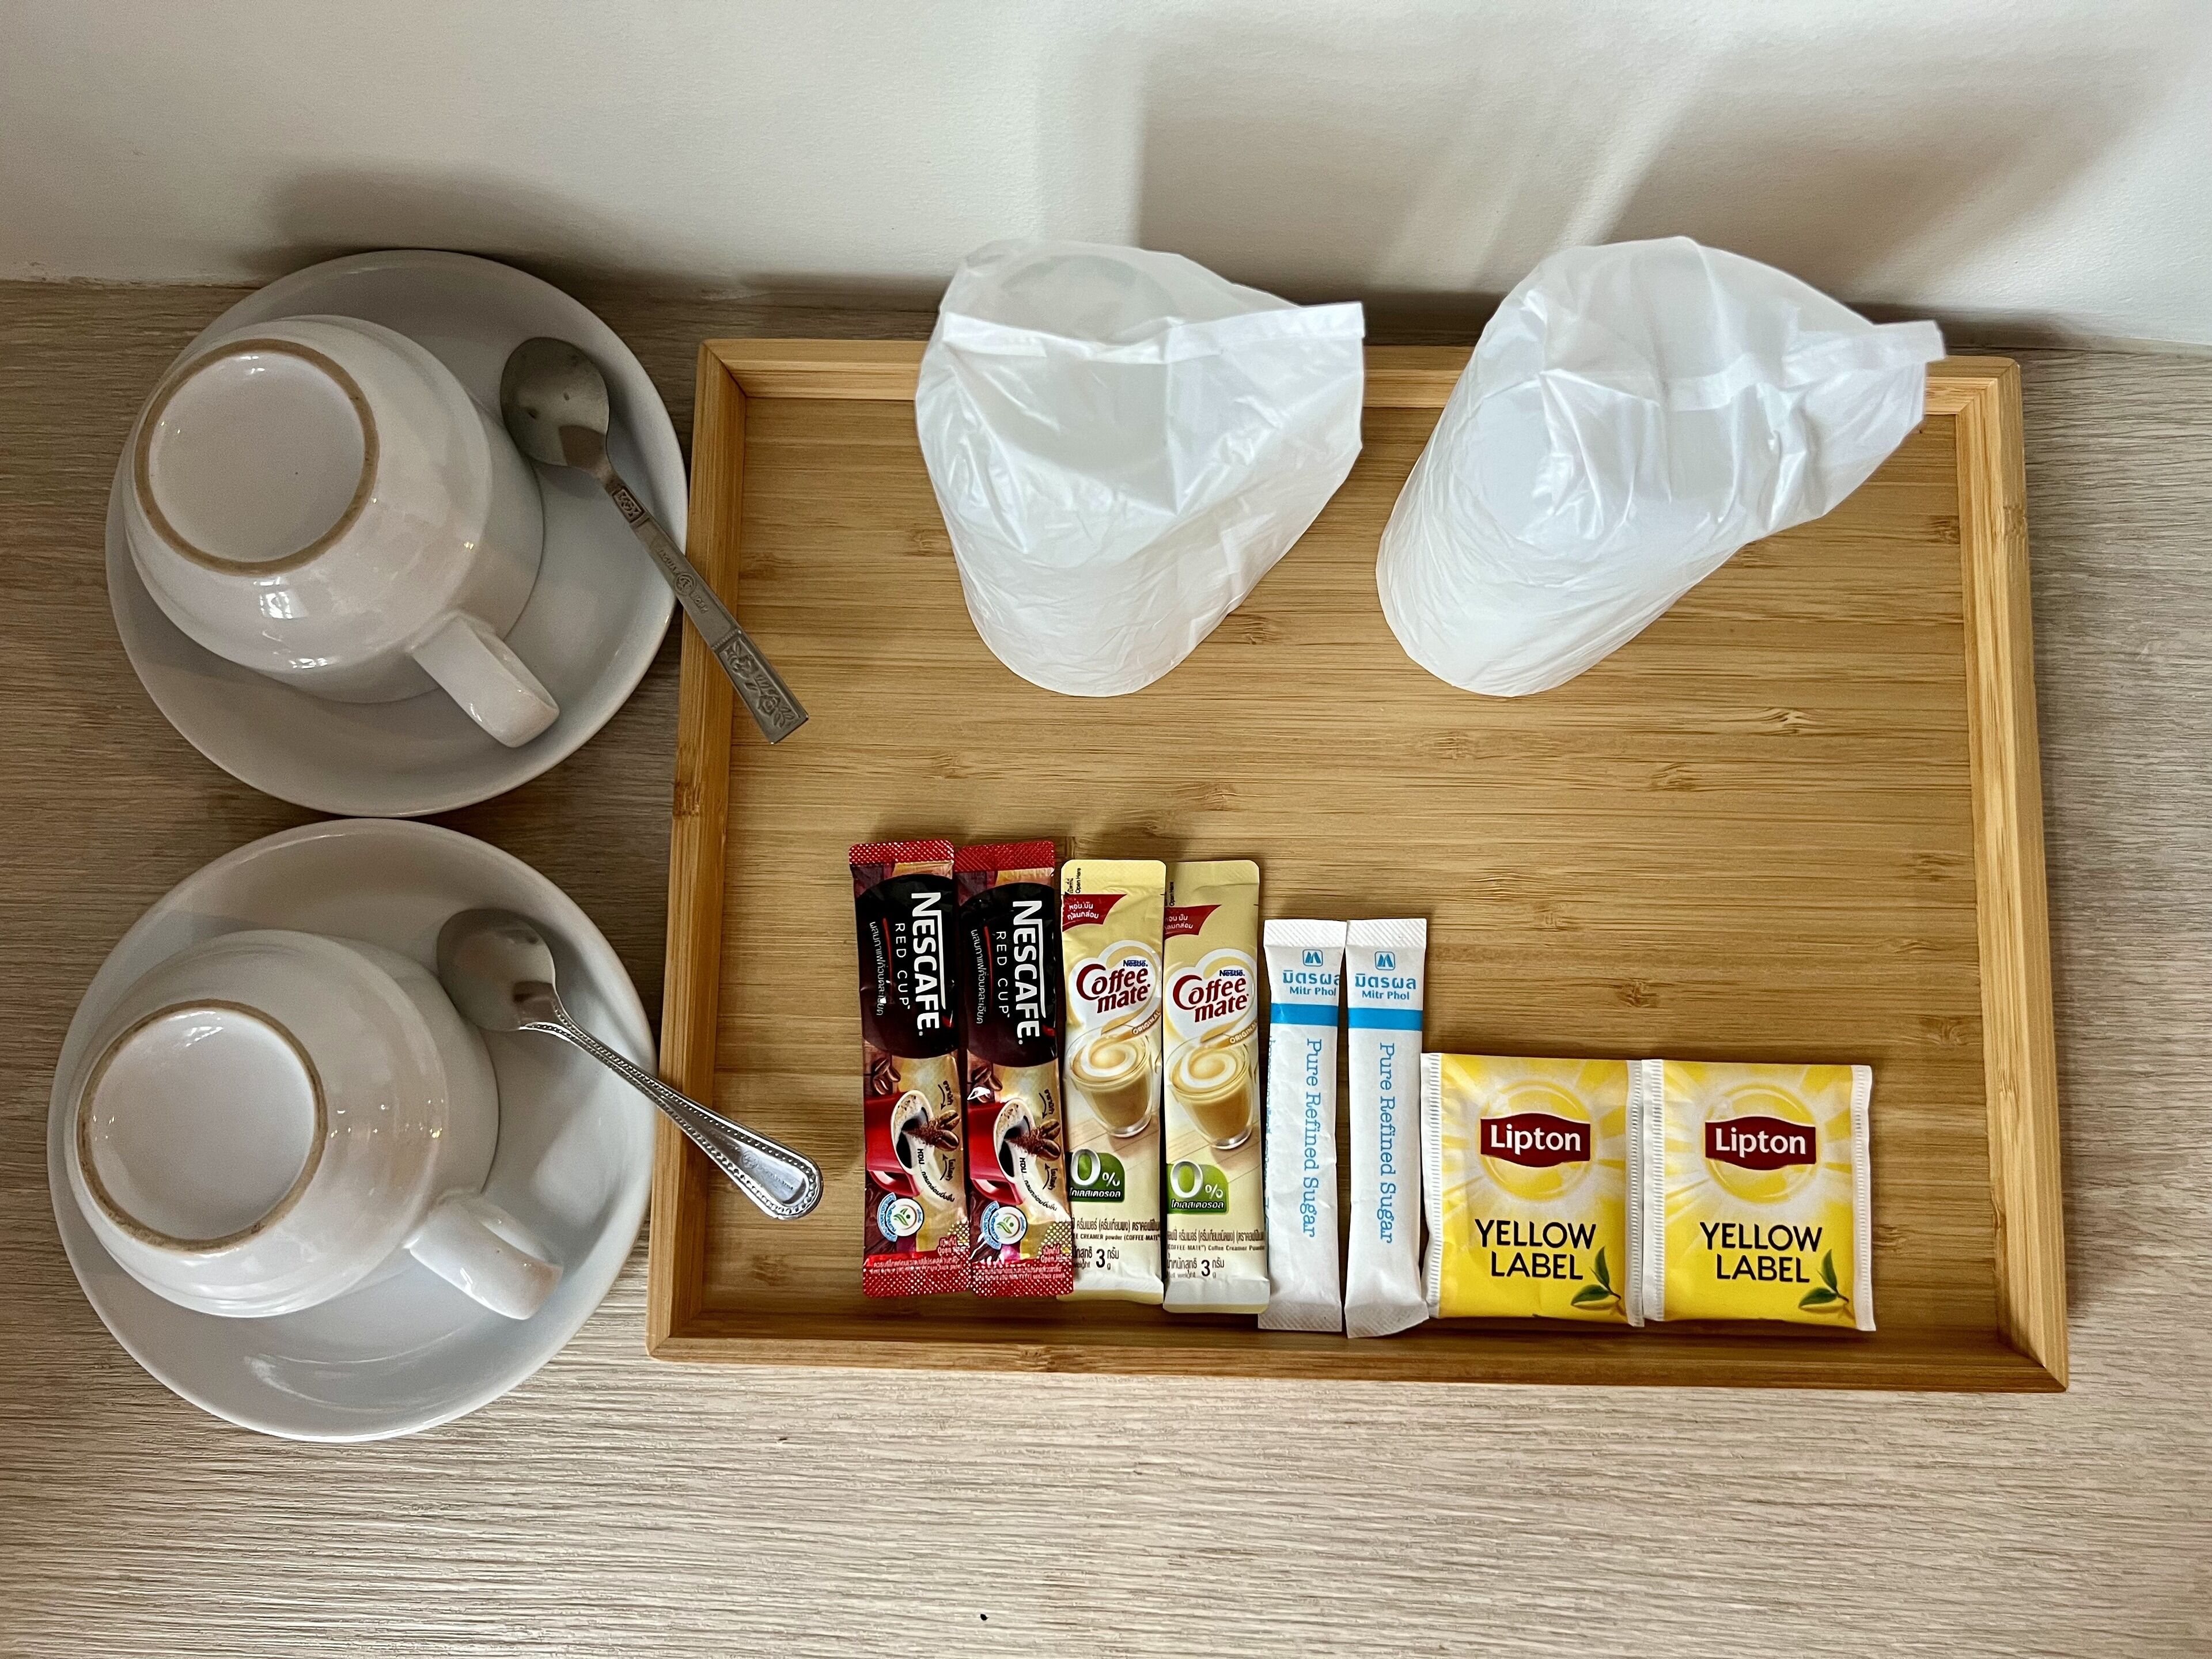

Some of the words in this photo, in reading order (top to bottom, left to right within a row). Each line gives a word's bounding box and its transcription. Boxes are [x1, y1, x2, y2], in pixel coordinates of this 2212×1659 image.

[895, 923, 906, 958] RED
[996, 931, 1007, 965] RED
[897, 971, 909, 1008] CUP
[1076, 964, 1148, 1001] Coffee
[1173, 975, 1247, 1010] Coffee
[1290, 986, 1312, 995] Mitr
[1315, 987, 1336, 997] Phol
[1355, 973, 1416, 990] มิตรผล
[1362, 990, 1384, 999] Mitr
[1387, 991, 1410, 1000] Phol
[998, 978, 1009, 1017] CUP
[1097, 986, 1149, 1013] mate
[1195, 995, 1248, 1022] mate
[1132, 1009, 1161, 1035] ORIGINAL
[1306, 1038, 1322, 1086] Pure
[1380, 1042, 1395, 1090] Pure
[1305, 1092, 1321, 1171] Refined
[1380, 1096, 1396, 1176] Refined
[1490, 1124, 1581, 1156] Lipton
[1715, 1127, 1806, 1158] Lipton
[1300, 1177, 1319, 1238] Sugar
[1377, 1183, 1396, 1244] Sugar
[1474, 1218, 1597, 1249] YELLOW
[1699, 1221, 1823, 1252] YELLOW
[1096, 1249, 1105, 1268] 3
[1201, 1259, 1210, 1277] 3
[1490, 1251, 1584, 1281] LABEL
[1716, 1253, 1810, 1283] LABEL
